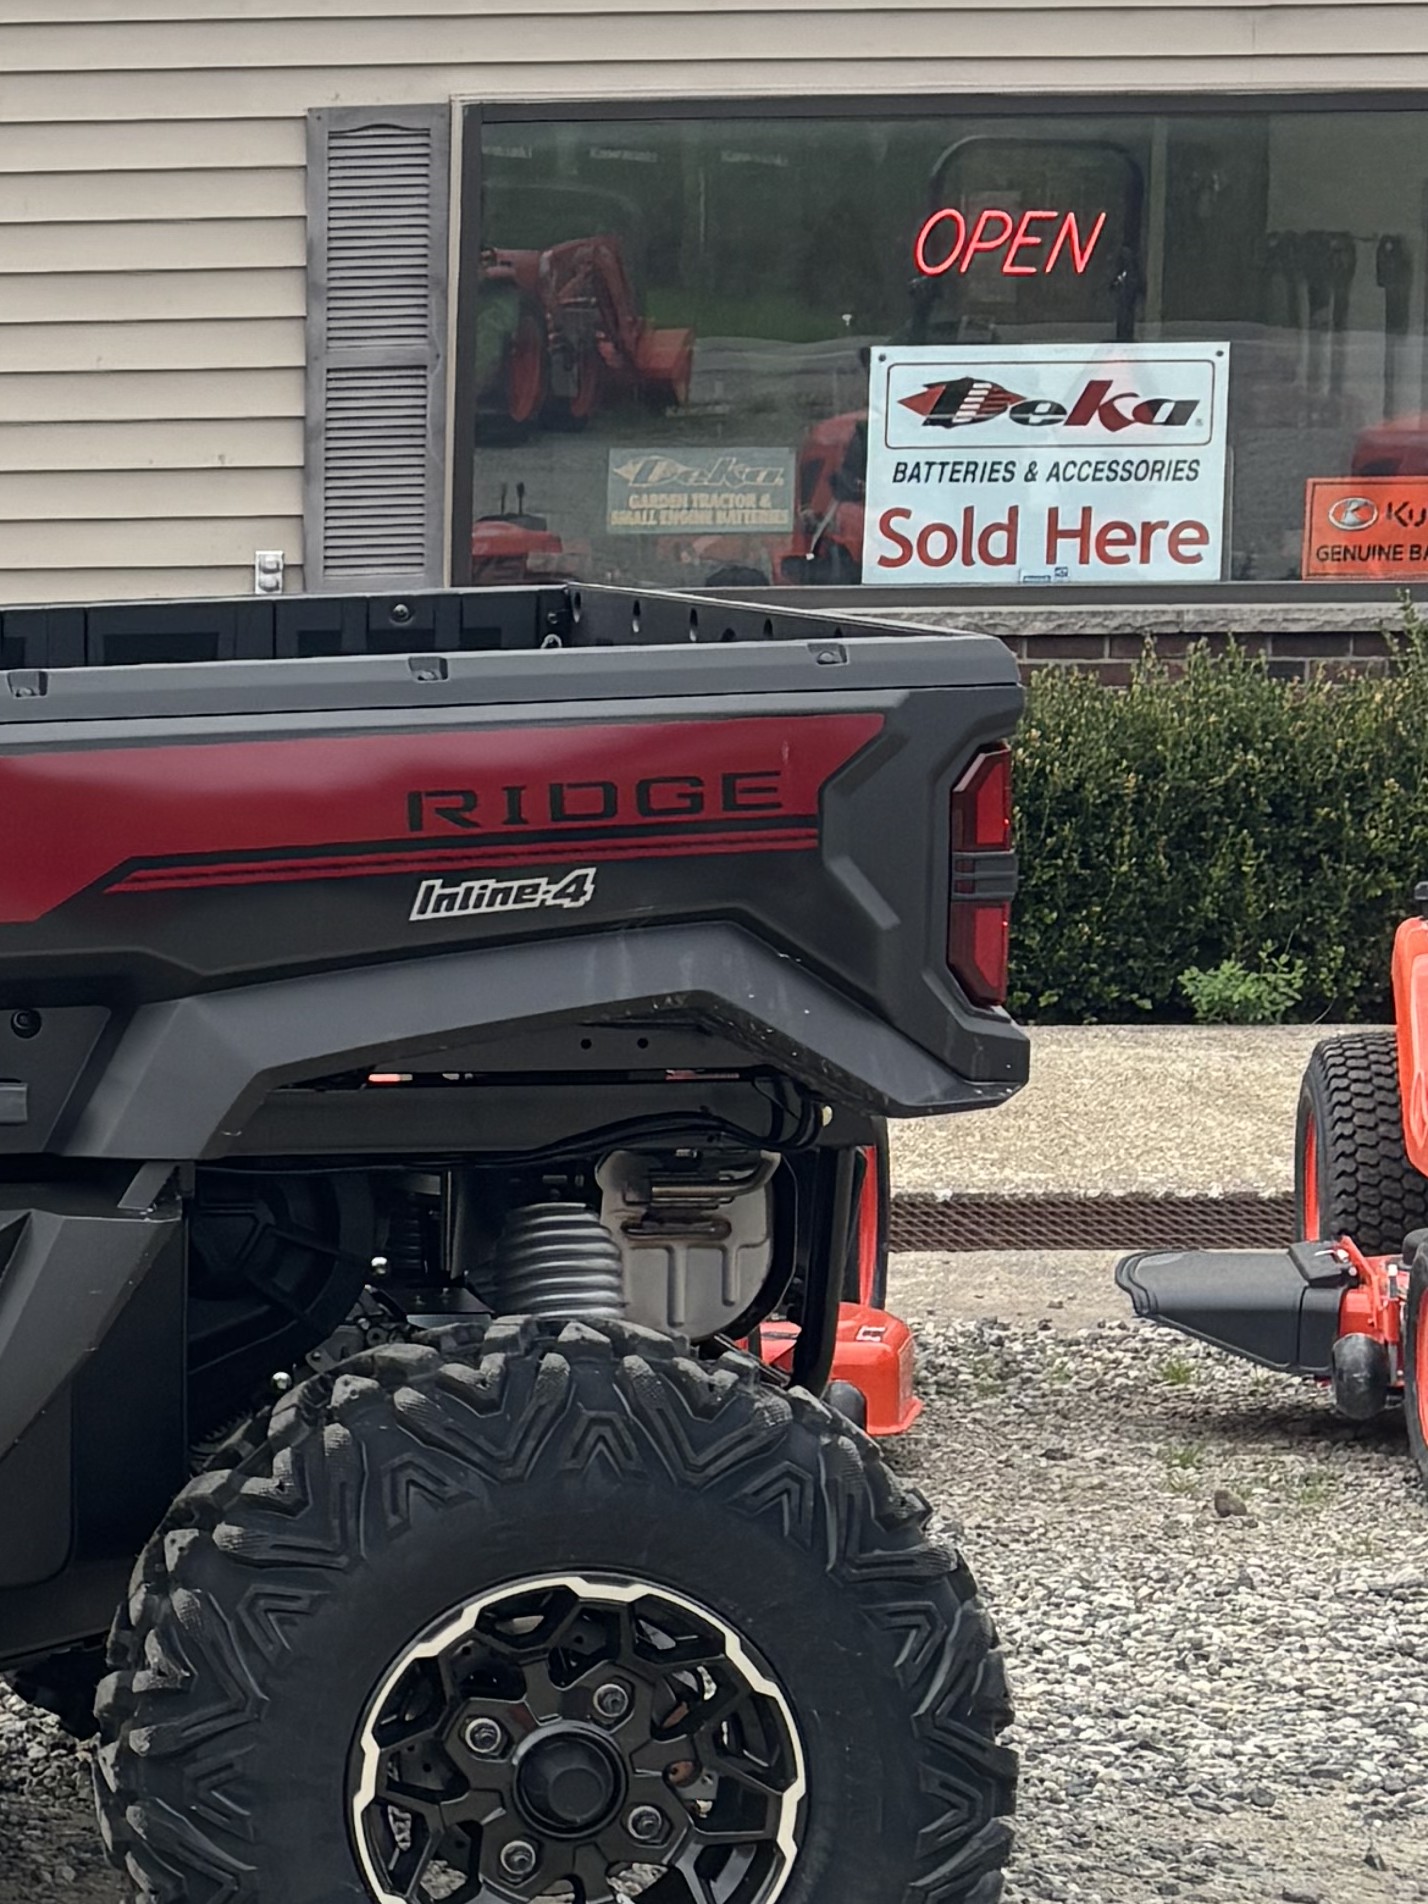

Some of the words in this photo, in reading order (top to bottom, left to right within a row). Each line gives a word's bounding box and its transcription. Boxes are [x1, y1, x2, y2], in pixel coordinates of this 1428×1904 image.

[913, 207, 1107, 278] OPEN
[897, 377, 1201, 432] Deka
[893, 460, 1016, 484] BATTERIES
[1024, 462, 1039, 483] &
[1046, 458, 1201, 483] ACCESSORIES
[877, 504, 1019, 568] Sold
[1045, 505, 1210, 566] Here
[1316, 543, 1405, 562] GENUINE
[407, 771, 783, 832] RIDGE
[409, 867, 597, 921] Inline-4
